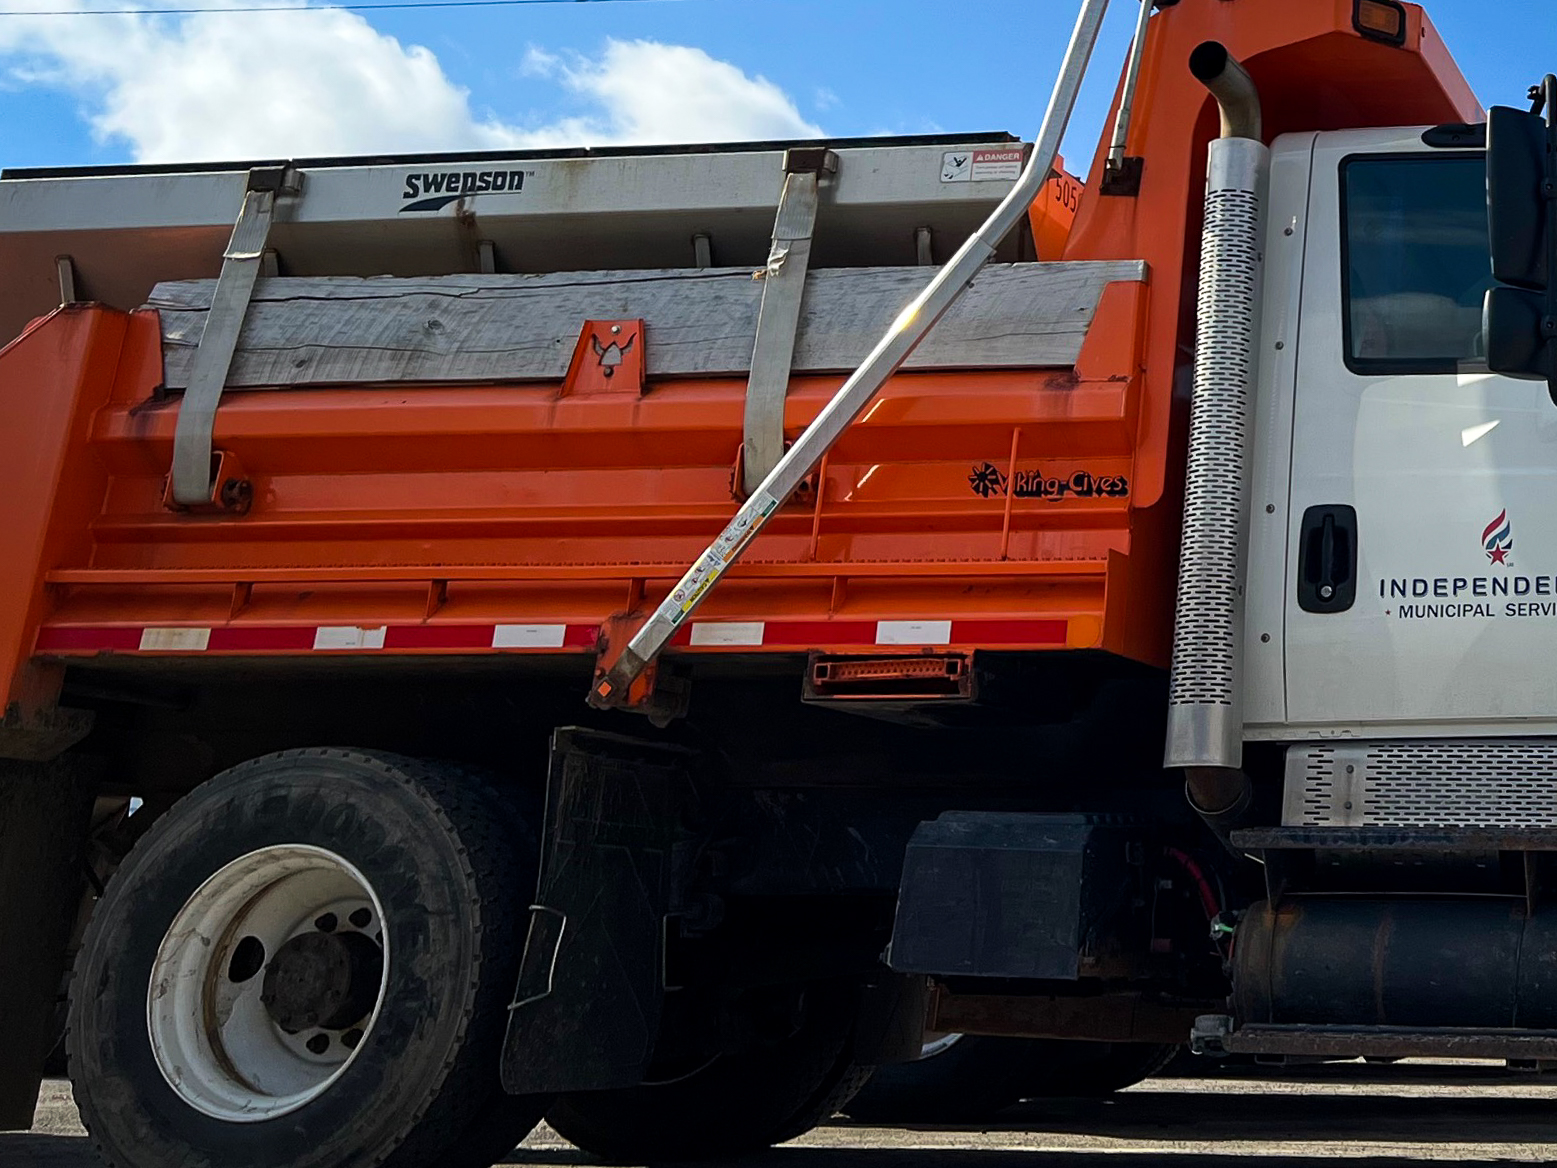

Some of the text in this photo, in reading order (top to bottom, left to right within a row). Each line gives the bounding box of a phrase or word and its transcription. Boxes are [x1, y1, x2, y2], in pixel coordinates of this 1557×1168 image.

[984, 152, 1020, 161] DANGER
[403, 170, 525, 198] Swenson
[1055, 177, 1083, 213] 505
[996, 469, 1128, 501] Vking-Cives
[1398, 603, 1496, 619] MUNICIPAL
